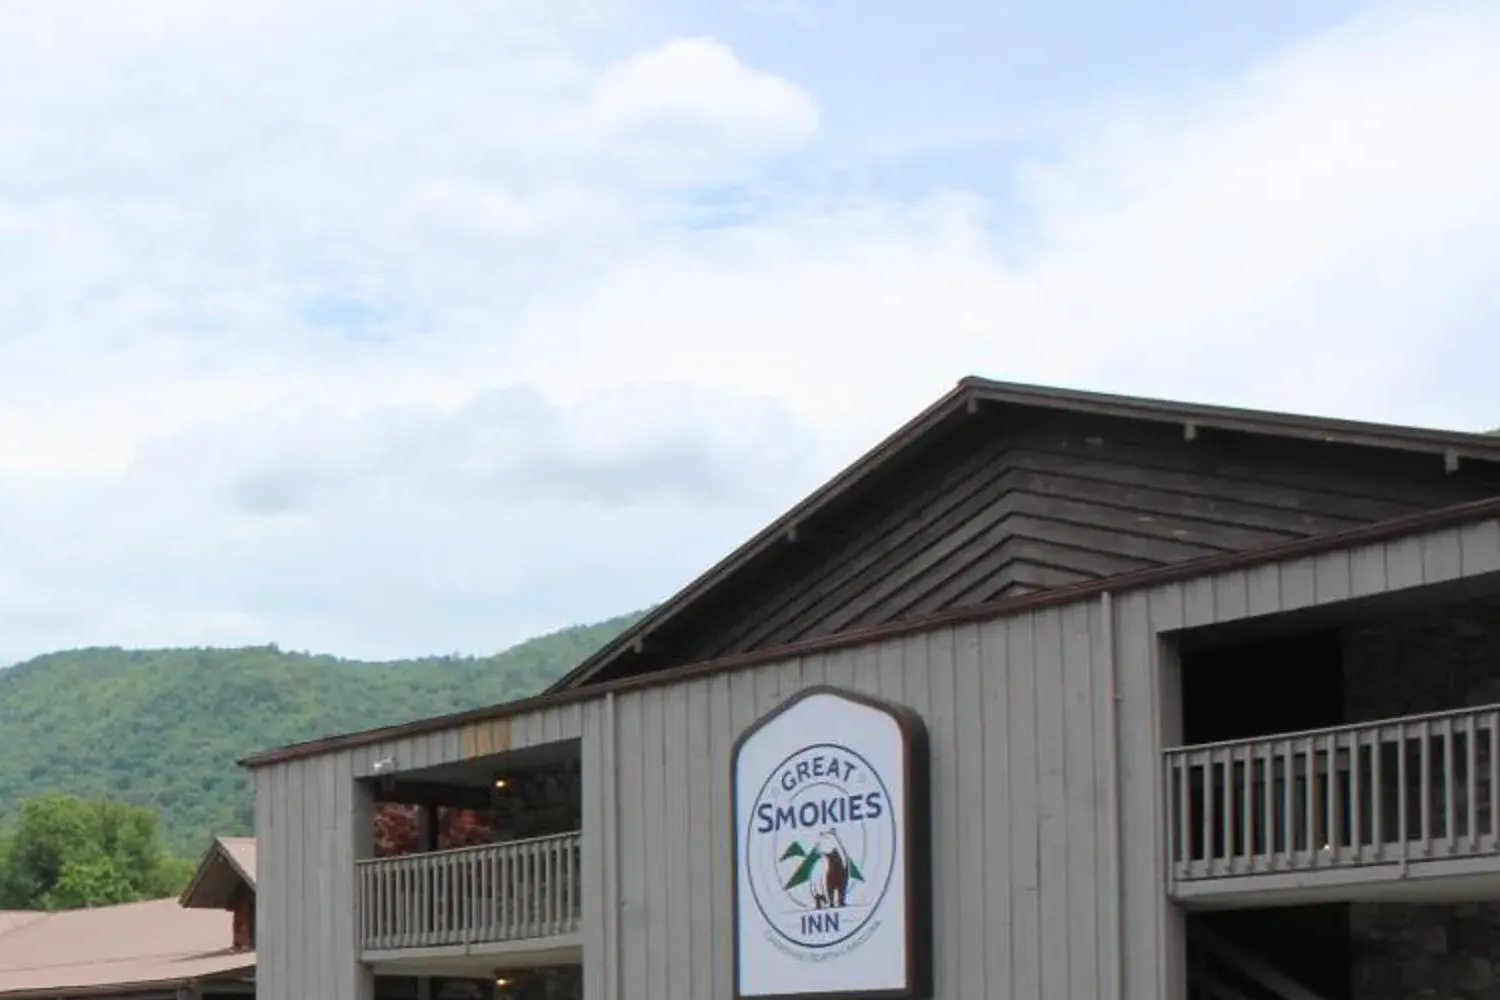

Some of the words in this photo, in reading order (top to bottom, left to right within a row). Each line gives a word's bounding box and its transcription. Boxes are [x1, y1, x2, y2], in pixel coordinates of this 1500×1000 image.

[781, 756, 857, 791] GREAT
[757, 792, 882, 833] SMOKIES
[801, 912, 839, 935] INN
